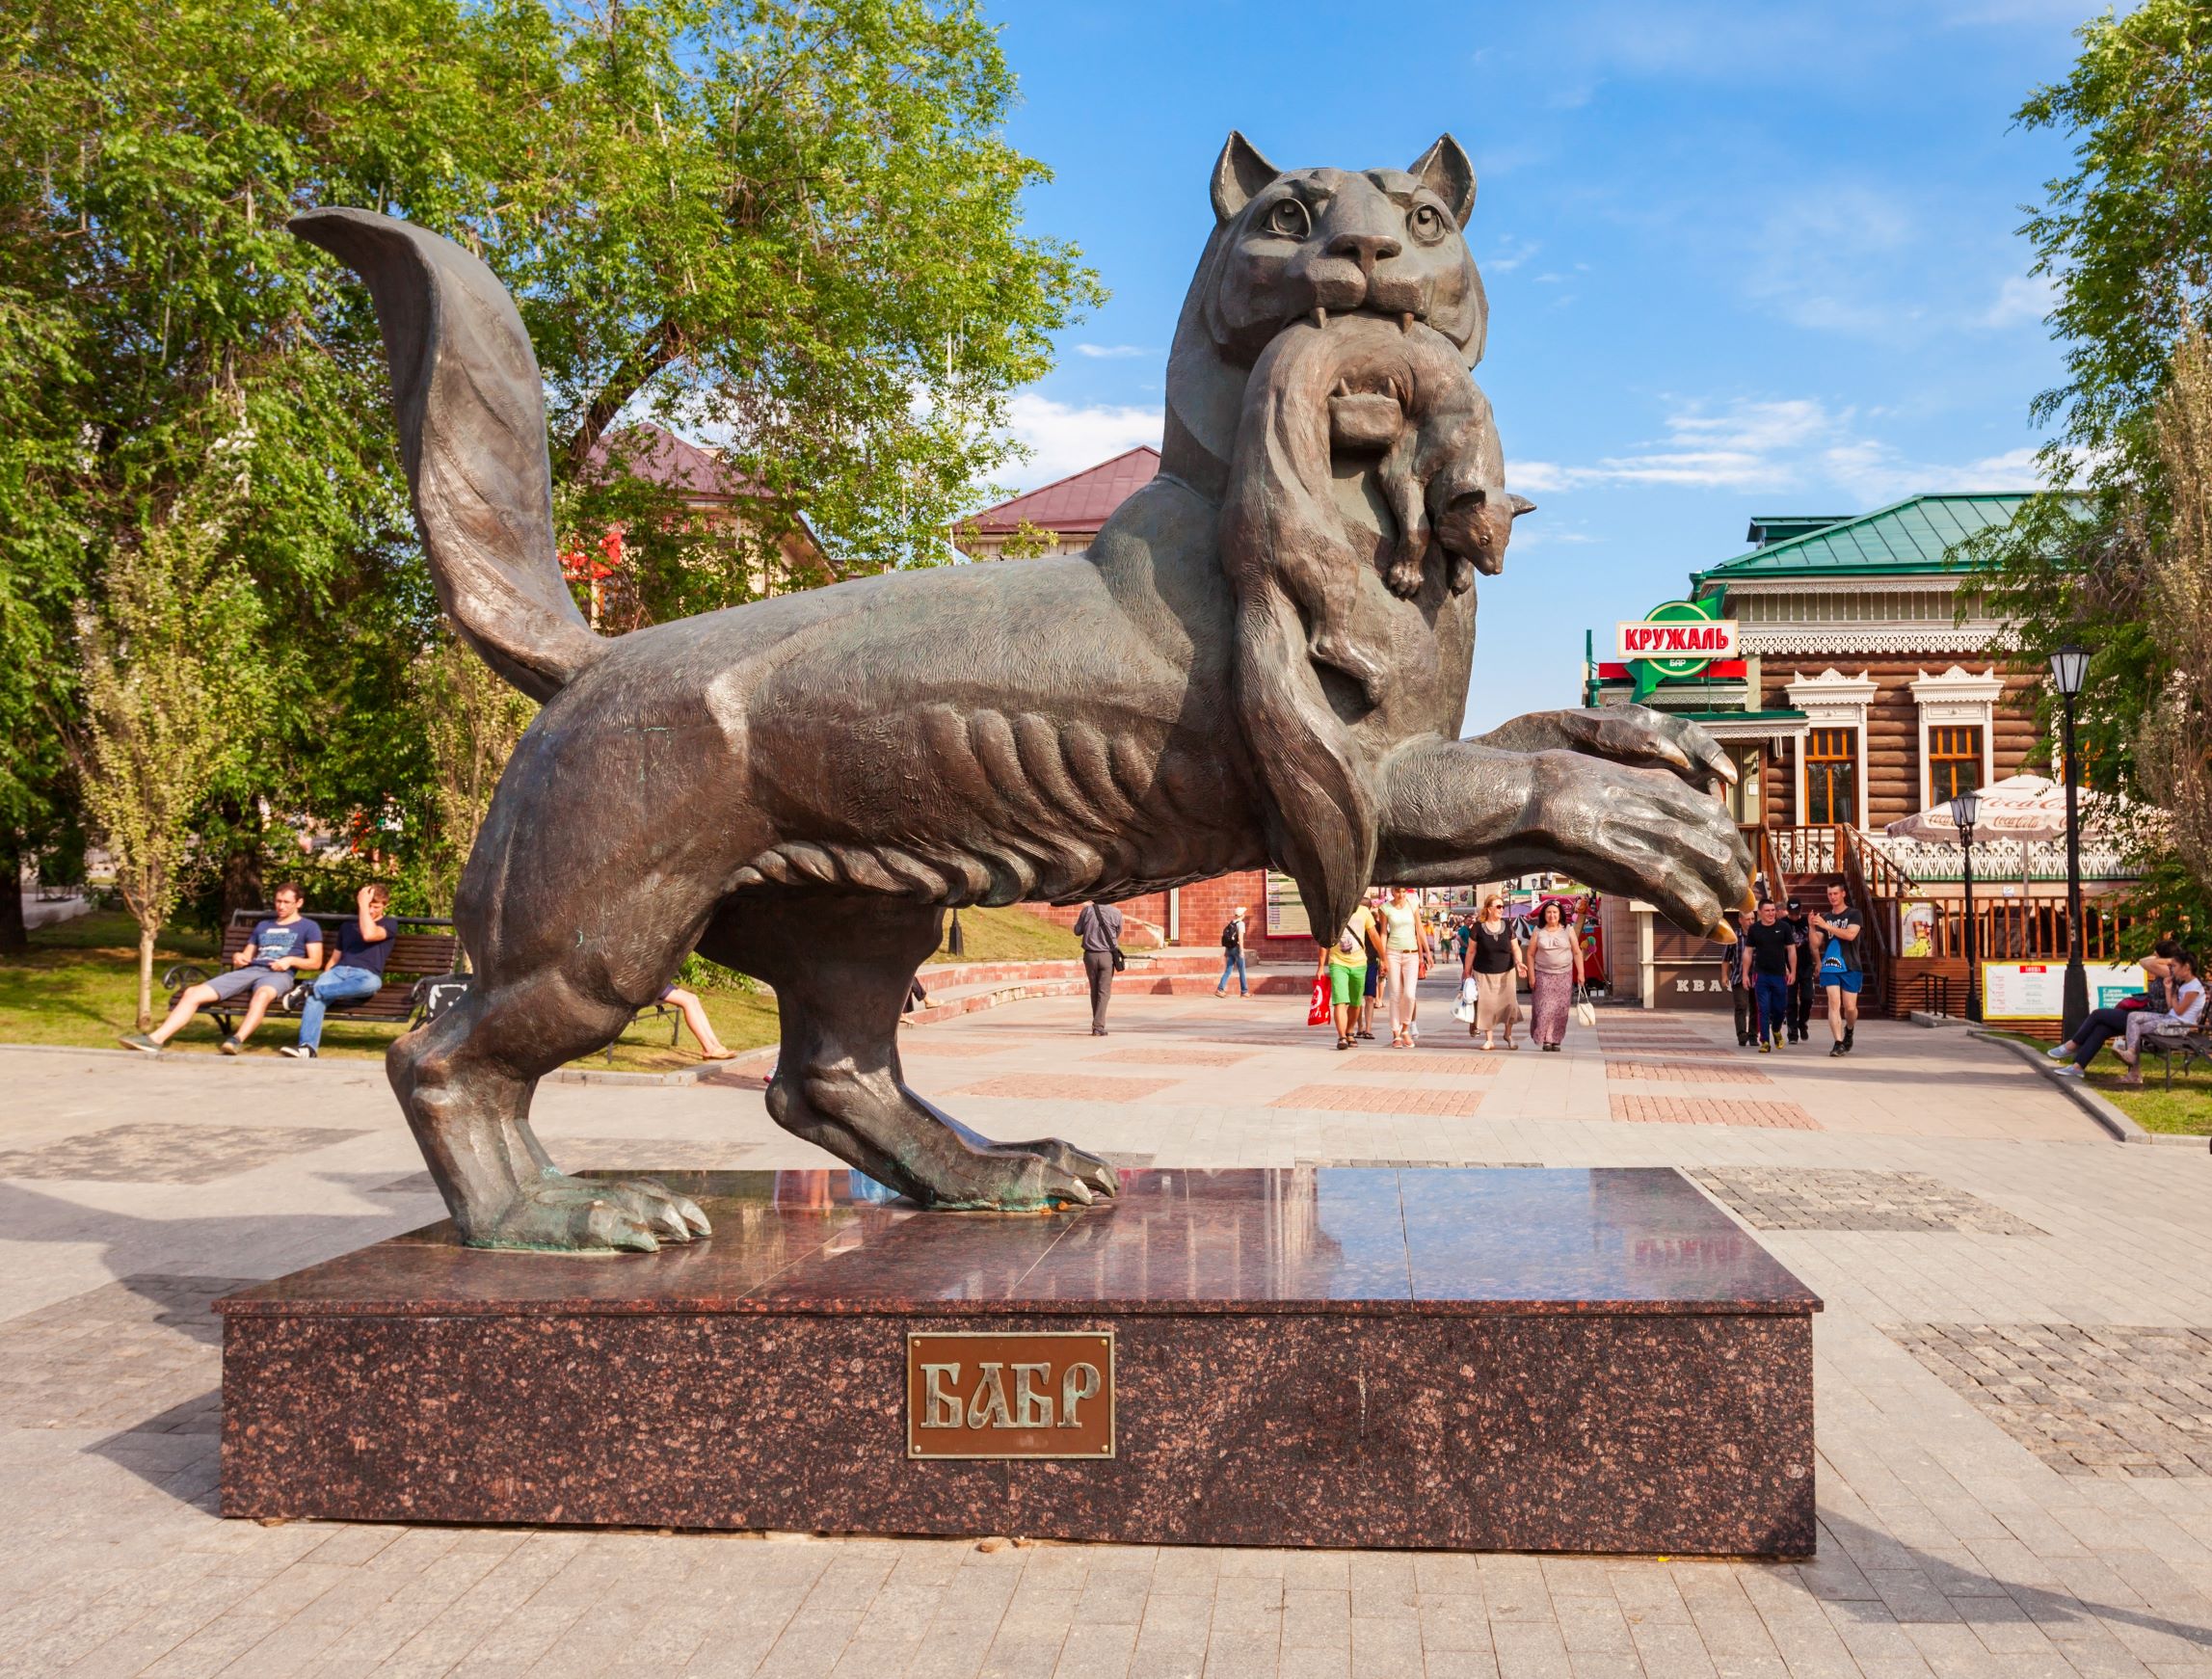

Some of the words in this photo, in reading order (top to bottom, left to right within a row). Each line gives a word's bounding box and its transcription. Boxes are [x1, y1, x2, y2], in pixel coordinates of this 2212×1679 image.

[1625, 627, 1729, 651] КРУЖАЛЬ
[1668, 658, 1687, 667] БАР
[1676, 979, 1733, 993] КВА
[919, 1361, 1101, 1429] БАБР
